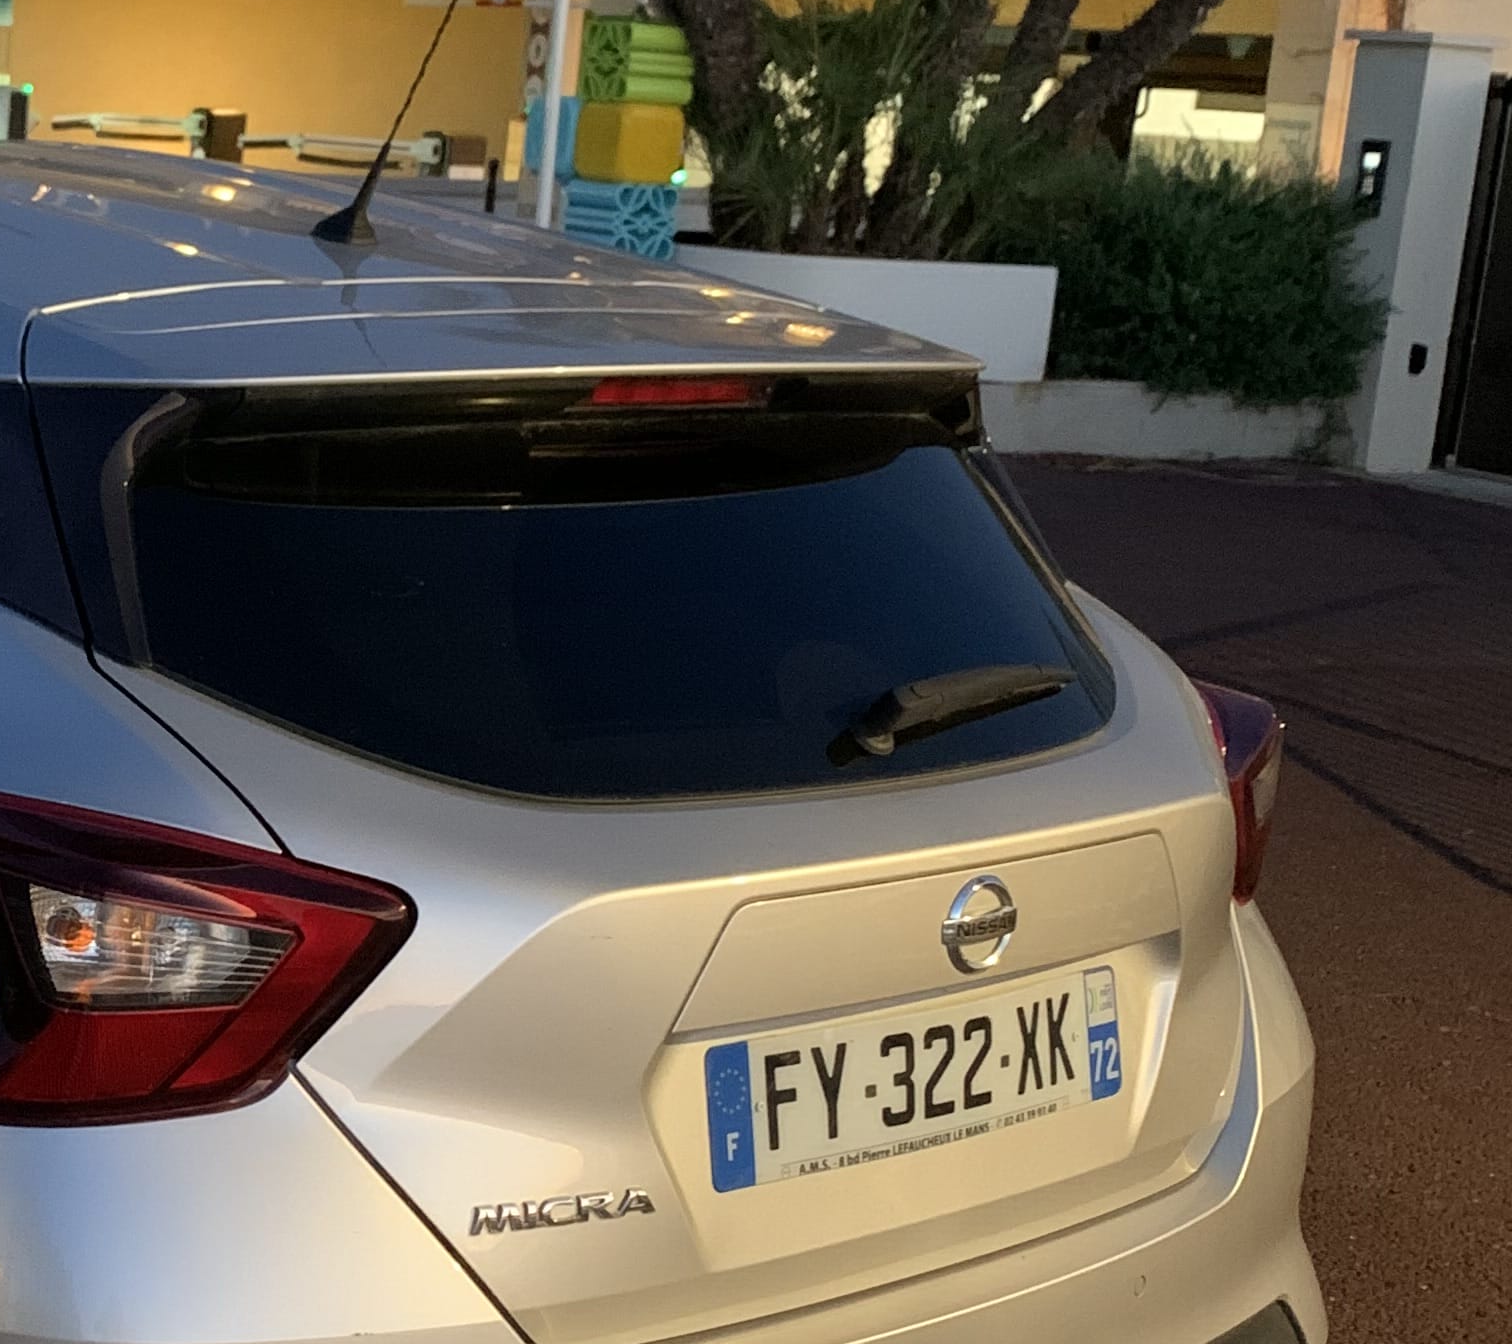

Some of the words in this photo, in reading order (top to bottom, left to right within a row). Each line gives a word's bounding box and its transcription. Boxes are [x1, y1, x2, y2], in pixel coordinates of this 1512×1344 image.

[1090, 1036, 1120, 1083] 72
[726, 1131, 740, 1162] F
[862, 1149, 891, 1163] Pierre
[953, 1128, 964, 1142] LE
[965, 1122, 990, 1138] MANS
[469, 1187, 656, 1236] MICRA
